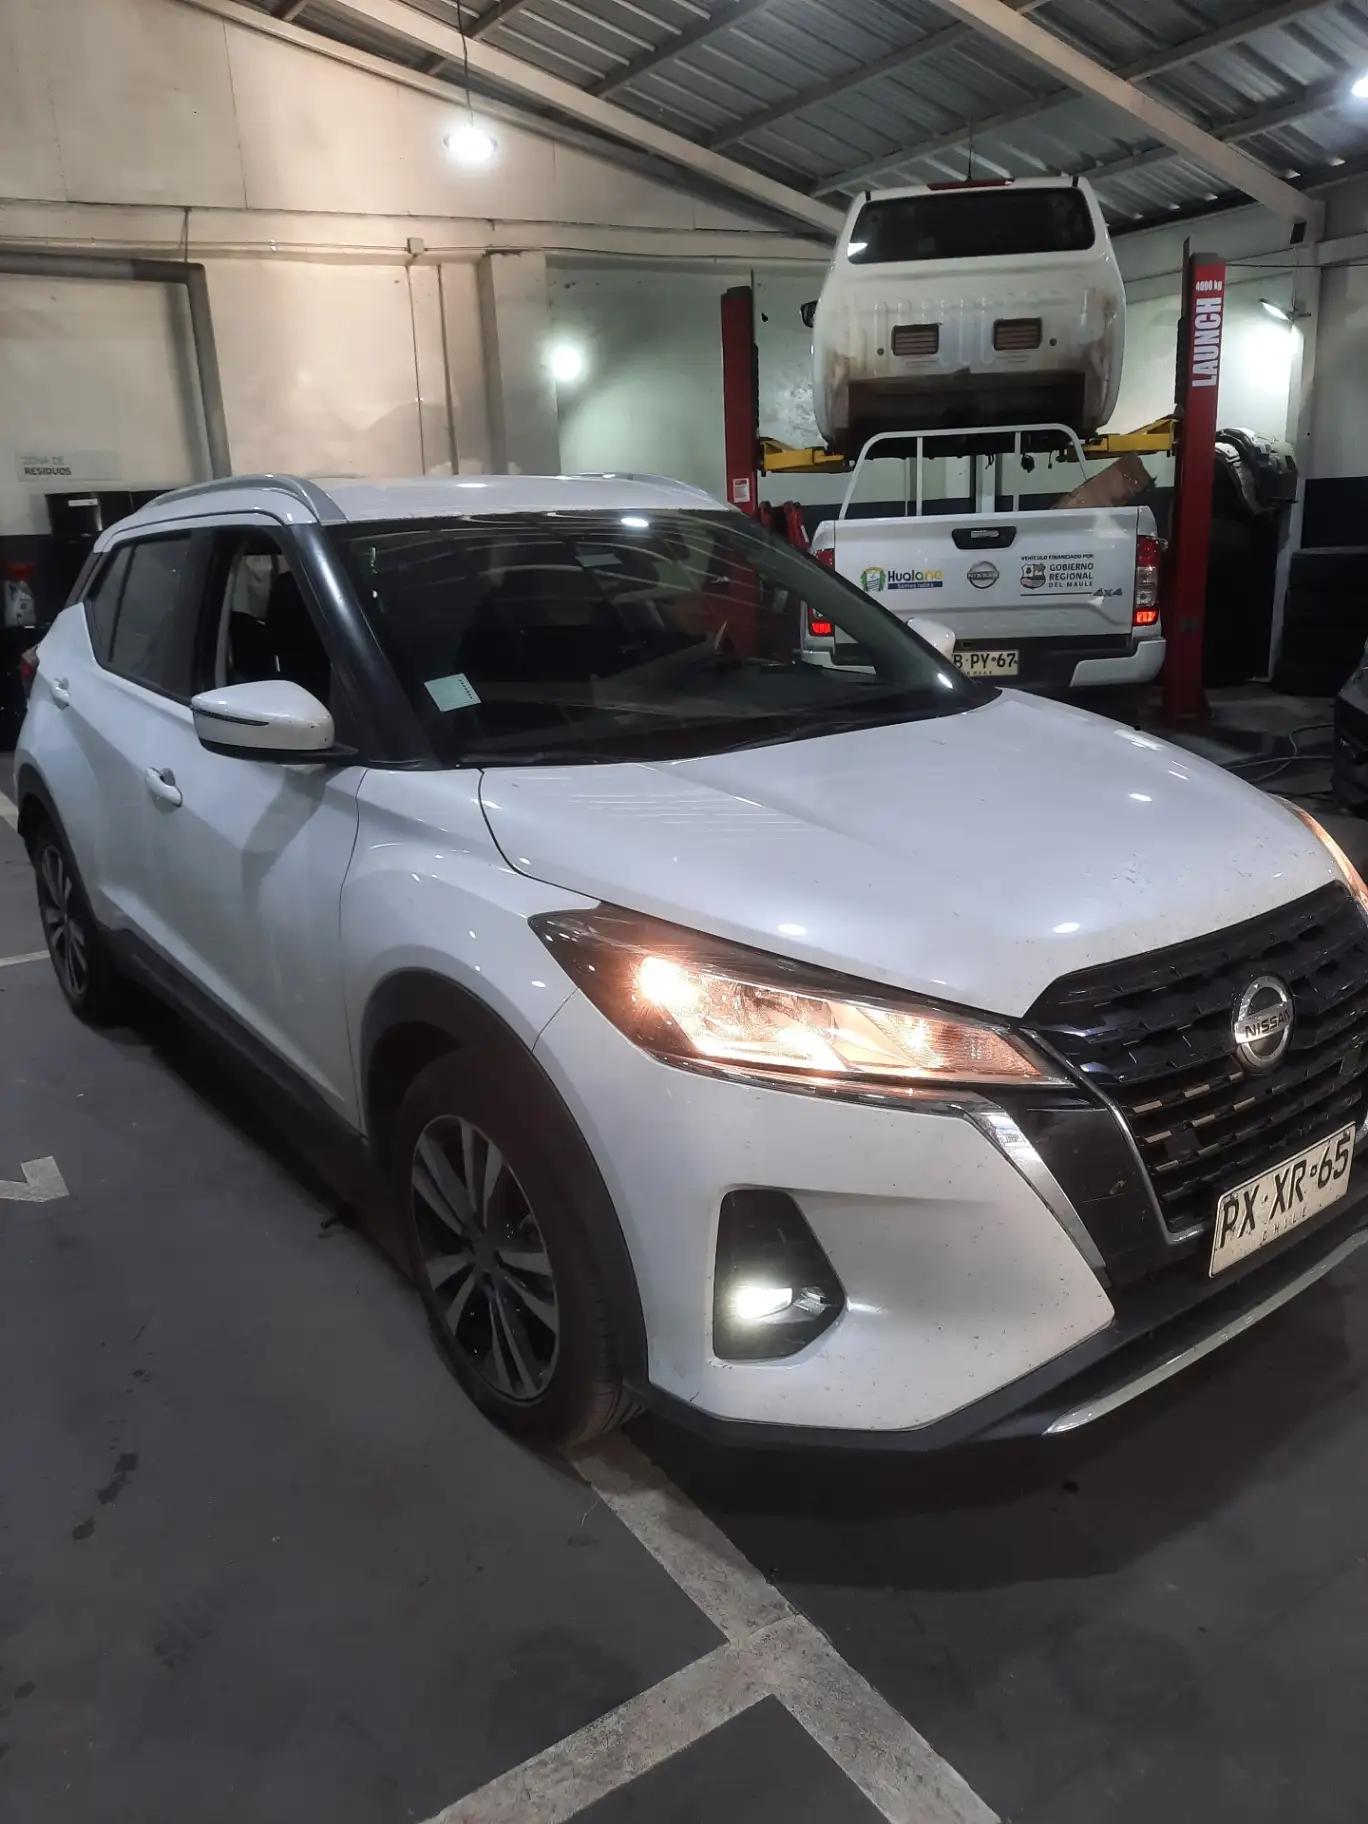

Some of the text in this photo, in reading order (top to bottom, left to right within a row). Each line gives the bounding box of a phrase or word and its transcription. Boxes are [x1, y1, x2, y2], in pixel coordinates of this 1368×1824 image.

[1192, 298, 1222, 387] LAUNCH
[24, 466, 72, 476] RESIDUOS
[1049, 562, 1094, 572] GOBIERNO
[1049, 572, 1093, 581] REGIONAL
